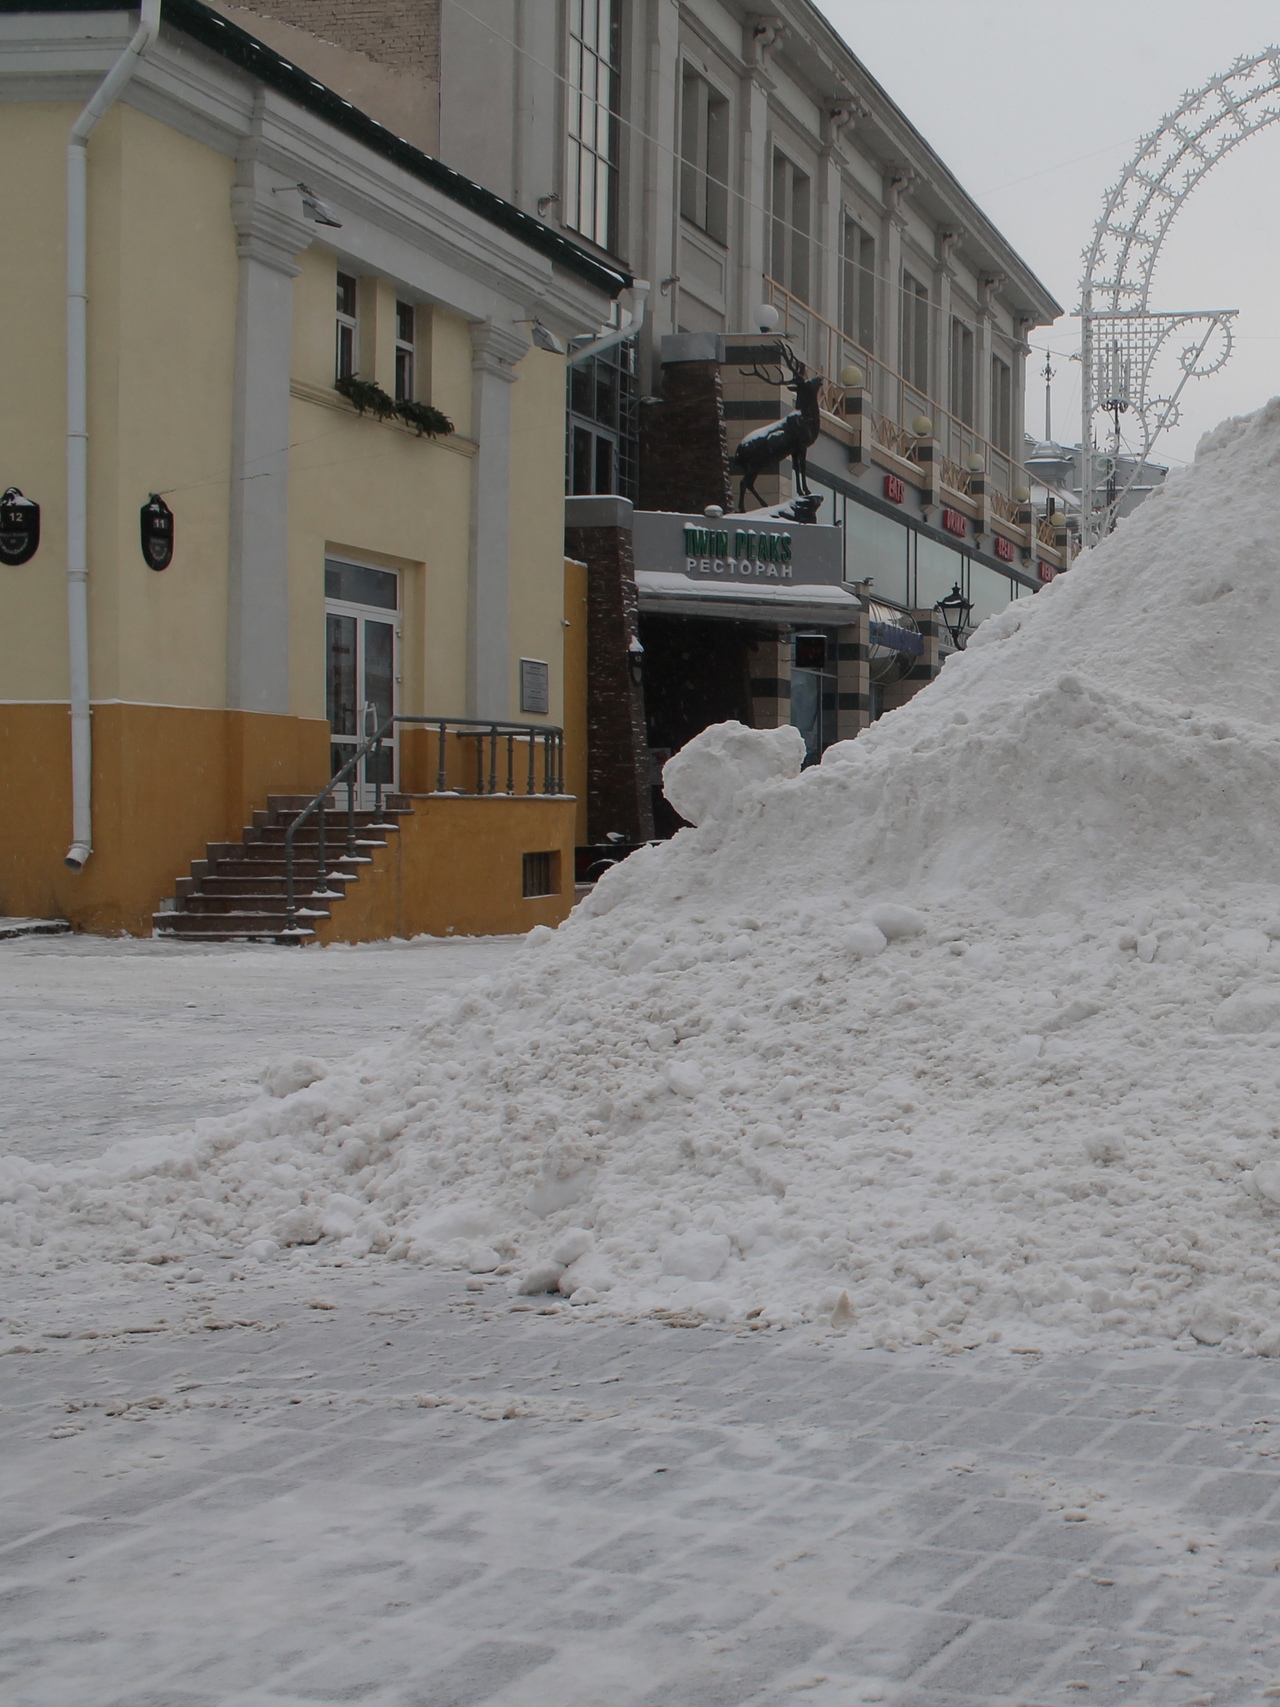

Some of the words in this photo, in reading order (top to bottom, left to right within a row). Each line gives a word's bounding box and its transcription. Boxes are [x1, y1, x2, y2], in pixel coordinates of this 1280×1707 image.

[886, 475, 904, 504] EATS
[10, 512, 23, 522] 12
[154, 518, 165, 528] 11
[736, 530, 792, 561] PEAKS
[686, 559, 793, 578] РЕСТОРАН
